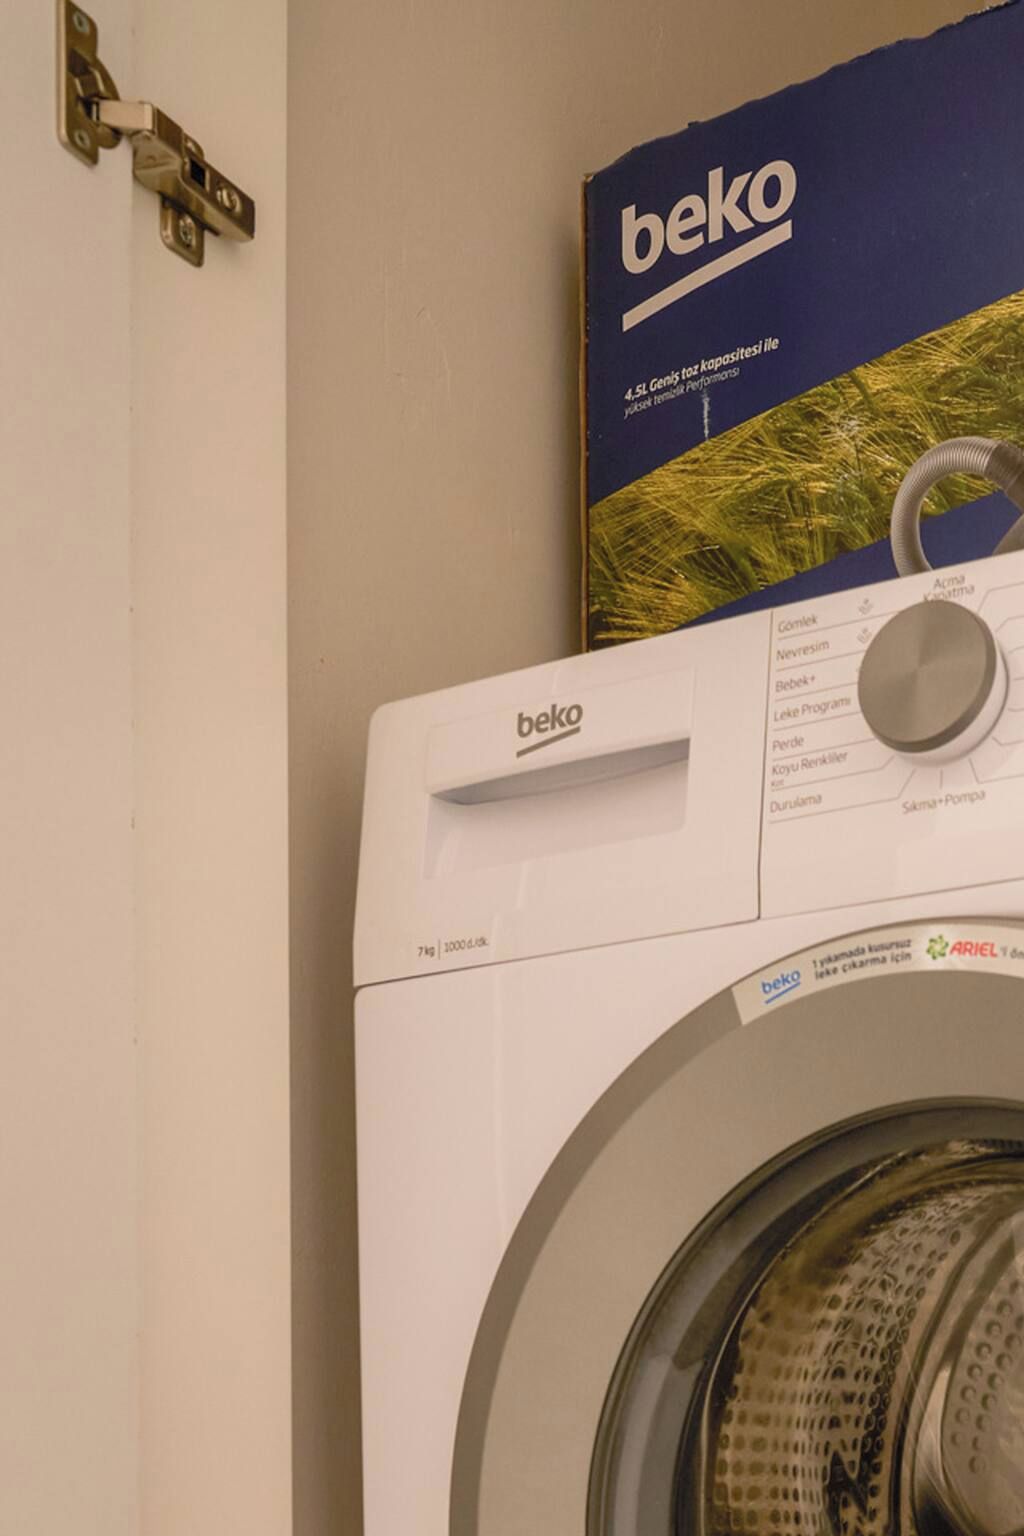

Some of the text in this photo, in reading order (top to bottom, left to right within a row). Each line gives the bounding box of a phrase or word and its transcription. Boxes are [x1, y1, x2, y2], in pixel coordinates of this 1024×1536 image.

[621, 159, 797, 275] beko
[624, 336, 780, 401] 4,5L Geniş toz kapasitesi ile
[624, 366, 741, 420] yüksek temizlik Performansı
[933, 574, 966, 591] Açma
[777, 614, 818, 633] Gömlek
[776, 640, 830, 661] Nevresim
[775, 674, 816, 693] Bebek+
[517, 703, 583, 738] beko
[774, 697, 852, 722] Leke Programı
[772, 736, 805, 751] Perde
[771, 751, 848, 777] Koyu Renkliler
[769, 793, 823, 813] Durulama
[417, 946, 424, 957] 7
[424, 945, 435, 958] kg
[444, 939, 466, 953] 1000
[812, 938, 912, 969] 1 yıkamada kusursuz
[950, 940, 998, 959] ARIEL
[815, 951, 912, 980] leke çıkarma için
[761, 969, 801, 994] beko
